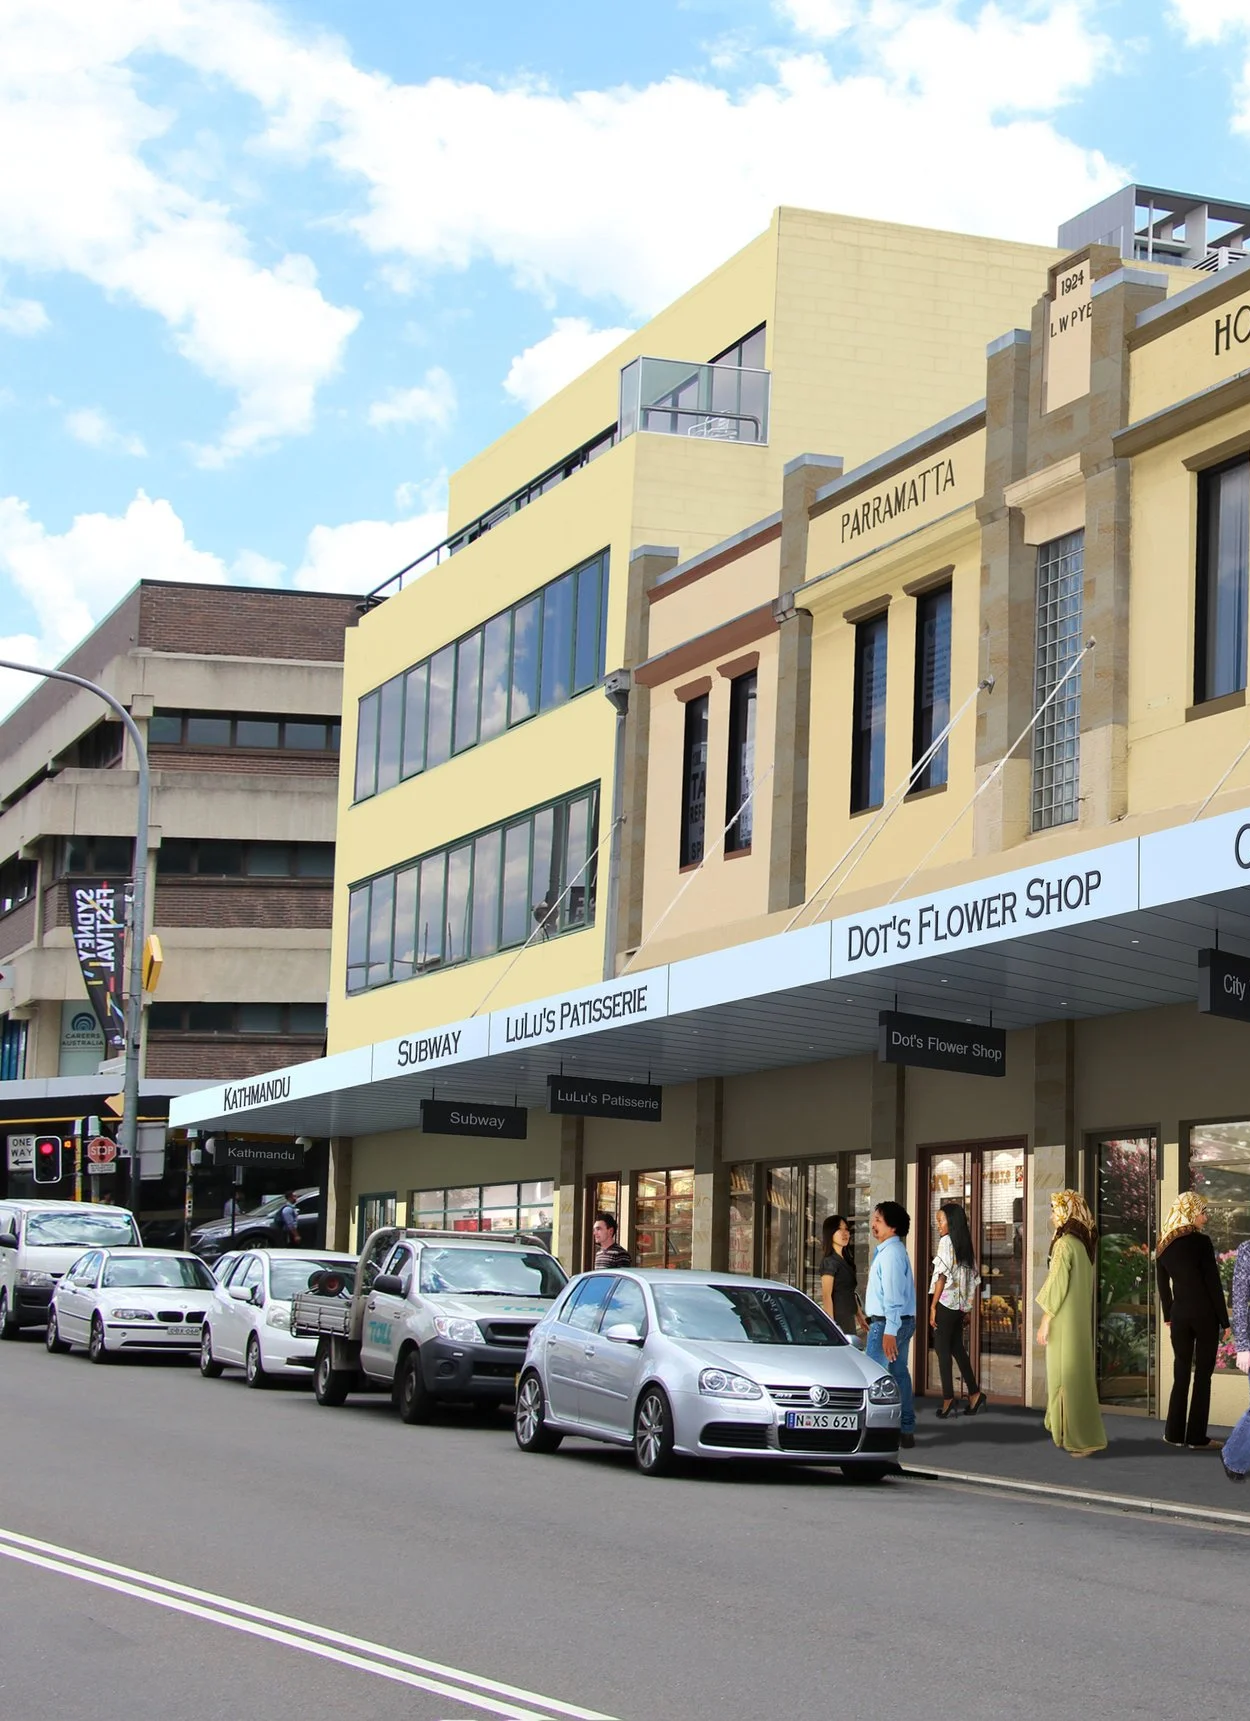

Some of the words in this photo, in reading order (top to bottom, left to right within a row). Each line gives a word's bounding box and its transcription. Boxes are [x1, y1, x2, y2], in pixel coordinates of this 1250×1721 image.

[1061, 269, 1084, 296] 1924
[840, 458, 956, 544] PARRAMATTA
[847, 915, 911, 962] DOT'S
[918, 891, 1017, 945] FLOWER
[1025, 870, 1102, 919] SHOP
[1223, 974, 1246, 1001] City
[560, 985, 648, 1031] PATISSERIE
[397, 1030, 462, 1067] SUBWAY
[891, 1031, 923, 1049] Dot's
[928, 1037, 969, 1055] Flower
[972, 1043, 1002, 1062] Shop
[223, 1075, 291, 1112] KATHMANDU
[557, 1089, 598, 1104] LuLu's
[602, 1094, 659, 1110] Patisserie
[450, 1111, 505, 1129] Subway
[11, 1149, 32, 1157] WAY
[12, 1138, 31, 1147] ONE
[91, 1146, 114, 1155] STOP
[228, 1147, 296, 1160] Kathmandu
[495, 1305, 547, 1313] TOL
[368, 1320, 392, 1345] TOLL
[833, 1416, 857, 1428] 62Y
